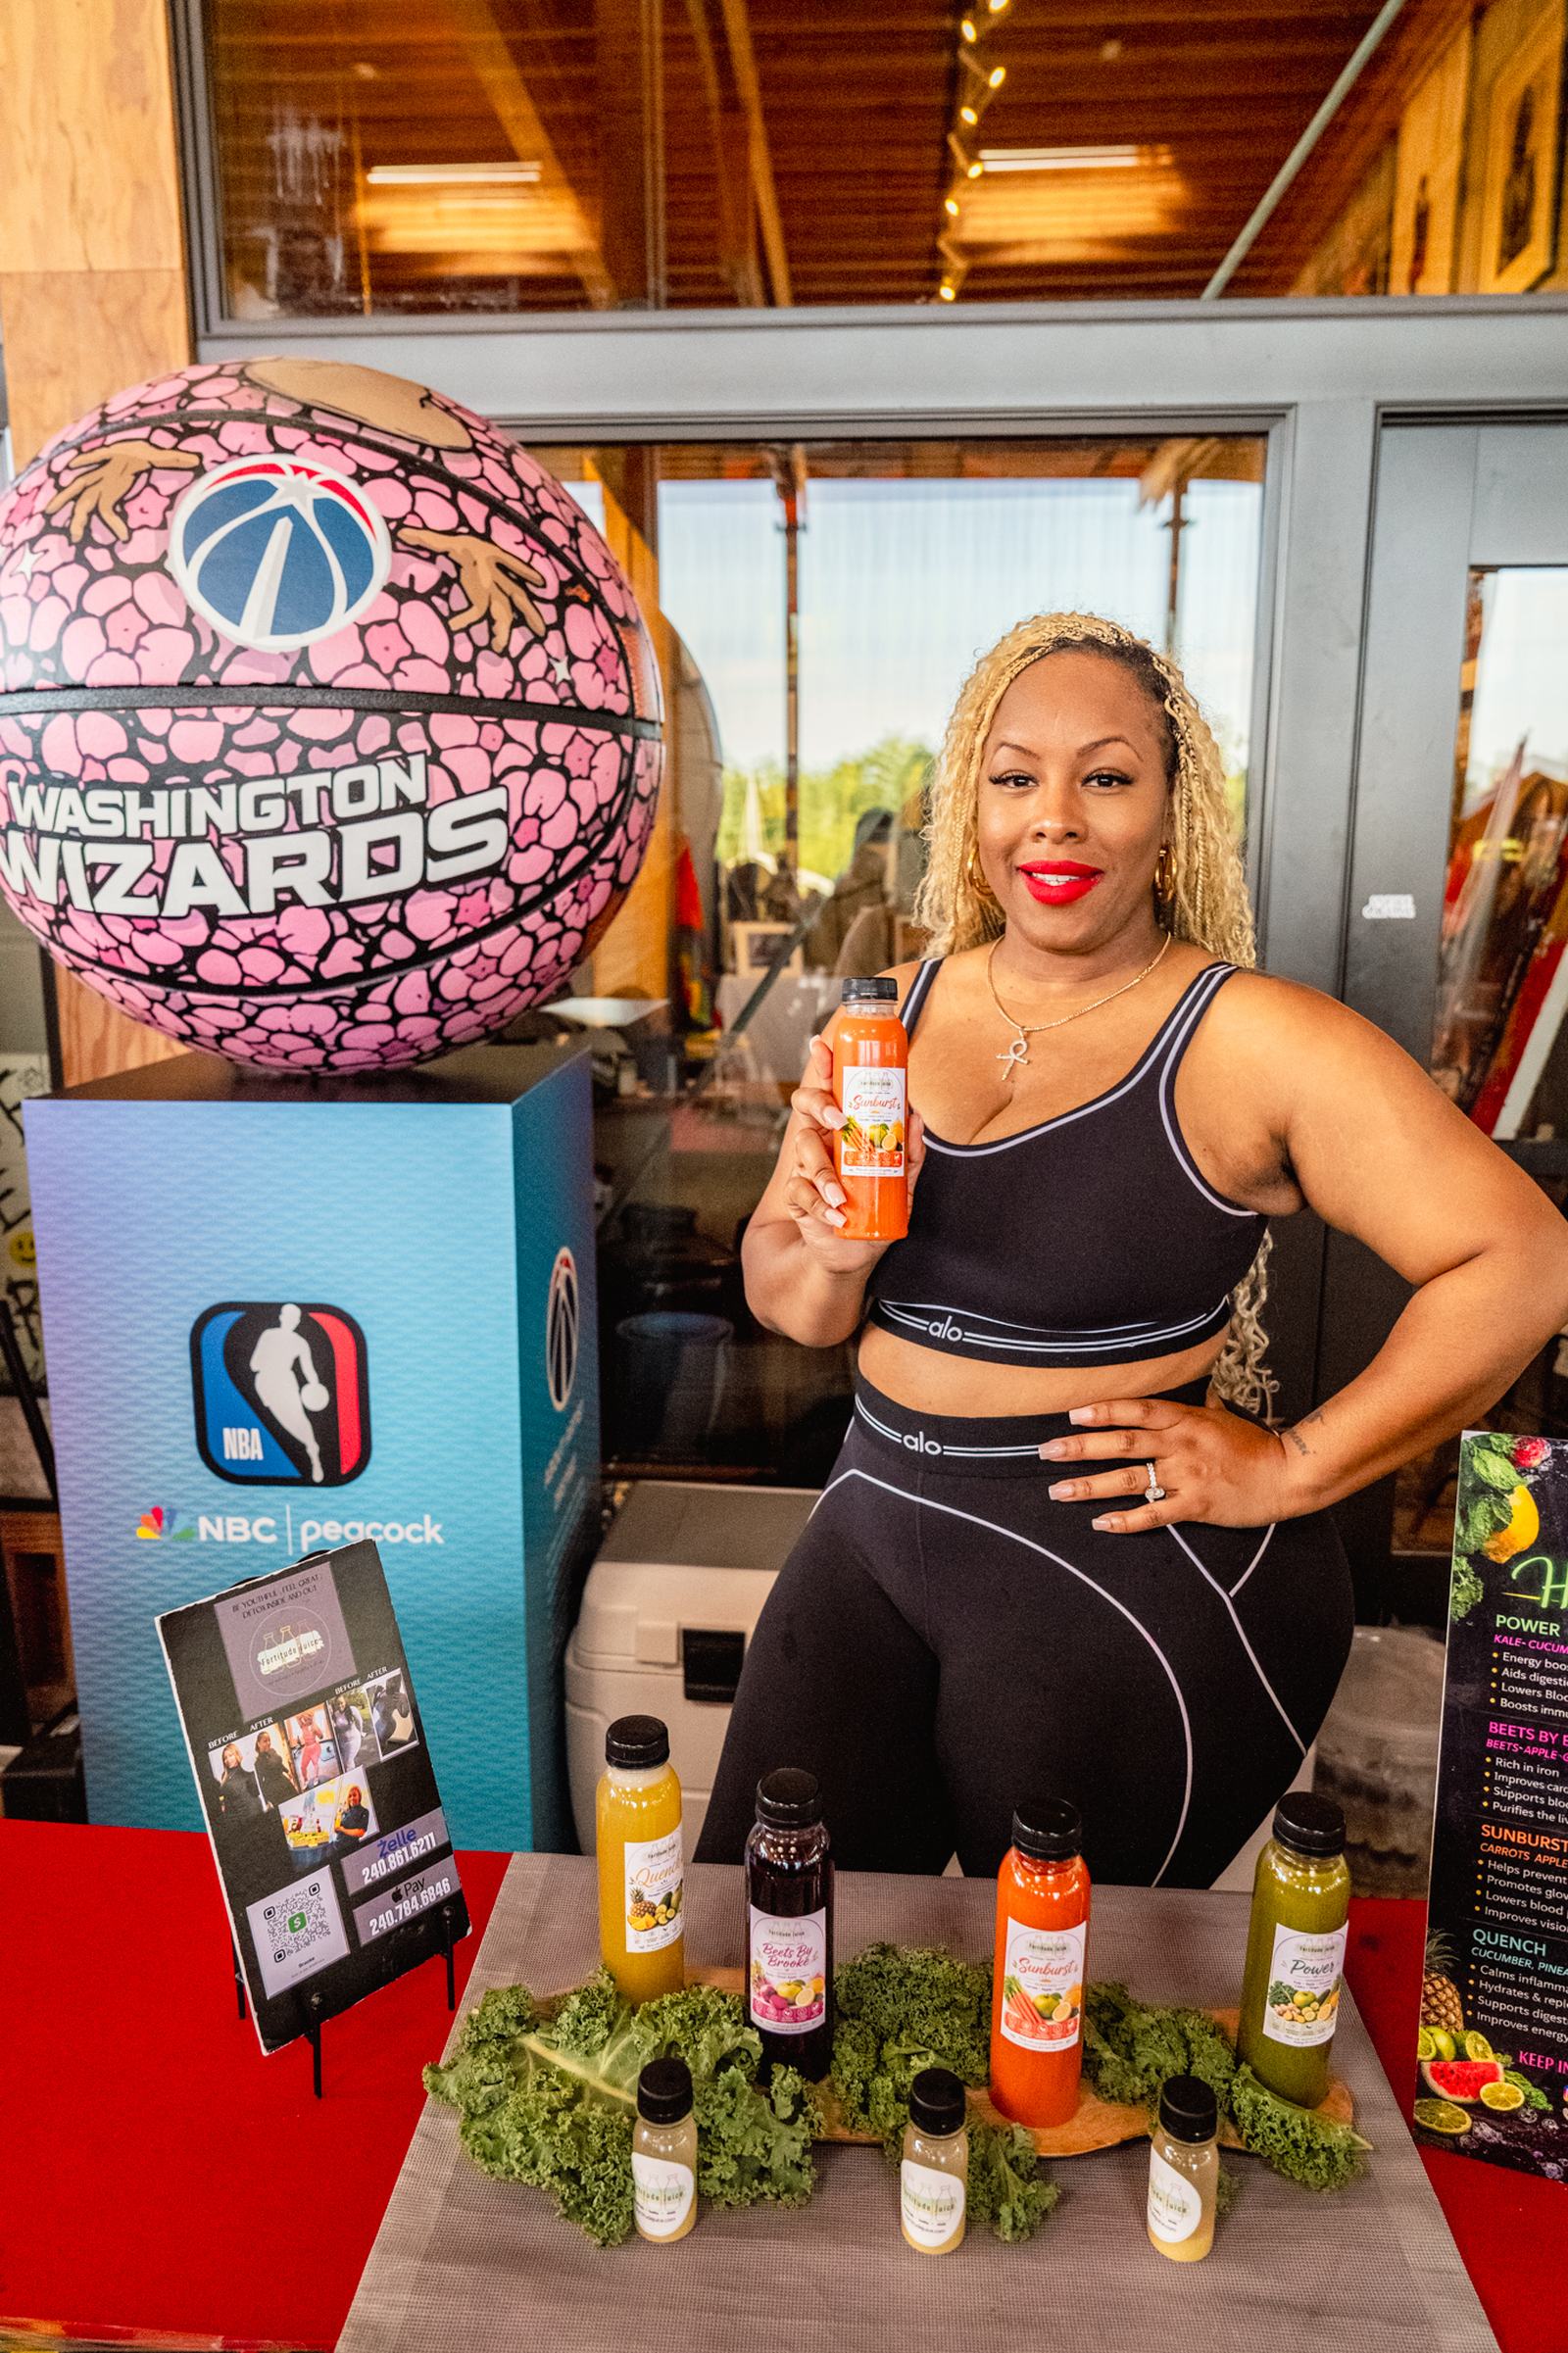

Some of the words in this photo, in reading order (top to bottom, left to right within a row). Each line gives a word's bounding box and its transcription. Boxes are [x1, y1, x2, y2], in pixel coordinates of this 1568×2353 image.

[8, 753, 427, 838] WASHINGTON
[0, 786, 509, 917] WIZARDS
[853, 1095, 898, 1110] Sunburst
[928, 1315, 963, 1342] alo
[221, 1427, 265, 1461] NBA
[903, 1431, 942, 1455] alo
[198, 1516, 277, 1543] NBC
[300, 1514, 445, 1552] peacock
[1495, 1614, 1560, 1638] POWER
[1494, 1634, 1527, 1647] KALE-
[261, 1647, 297, 1666] Fortitude
[1502, 1651, 1542, 1669] Energy
[334, 1679, 362, 1695] BEFORE
[367, 1666, 388, 1680] AFTER
[1501, 1667, 1527, 1680] Aids
[1501, 1682, 1543, 1698] Lowers
[1499, 1697, 1539, 1713] Boosts
[208, 1731, 239, 1750] BEFORE
[249, 1717, 274, 1733] AFTER
[1489, 1721, 1536, 1740] BEETS
[1539, 1730, 1559, 1744] BY
[1495, 1756, 1521, 1770] Rich
[1523, 1761, 1534, 1773] in
[1537, 1764, 1560, 1778] iron
[1494, 1771, 1545, 1789] Improves
[1493, 1786, 1545, 1805] Supports
[1493, 1801, 1535, 1818] Purifies
[1537, 1810, 1556, 1822] the
[1481, 1824, 1568, 1853] SUNBURST
[362, 1832, 437, 1886] 240.861.6211
[1480, 1842, 1531, 1861] CARROTS
[1534, 1853, 1568, 1869] APPLE
[1488, 1859, 1520, 1876] Helps
[1522, 1868, 1568, 1886] prevent
[404, 1878, 425, 1897] Pay
[1487, 1874, 1543, 1895] Promotes
[369, 1878, 452, 1936] 240.784.6846
[1486, 1889, 1528, 1908] Lowers
[1530, 1898, 1564, 1916] blood
[1484, 1905, 1539, 1927] Improves
[1540, 1919, 1568, 1934] visio
[762, 1942, 793, 1959] Beets
[796, 1943, 813, 1958] By
[1473, 1929, 1547, 1957] QUENCH
[767, 1954, 809, 1968] Brooke
[1019, 1957, 1075, 1977] Sunburst
[1290, 1959, 1335, 1975] Power
[1471, 1946, 1535, 1970] CUCUMBER,
[1480, 1964, 1516, 1982] Calms
[1479, 1980, 1530, 2001] Hydrates
[1532, 1992, 1542, 2003] &
[1477, 1995, 1530, 2017] Supports
[1477, 2011, 1529, 2034] Improves
[1531, 2024, 1568, 2044] energy
[1519, 2050, 1554, 2071] KEEP
